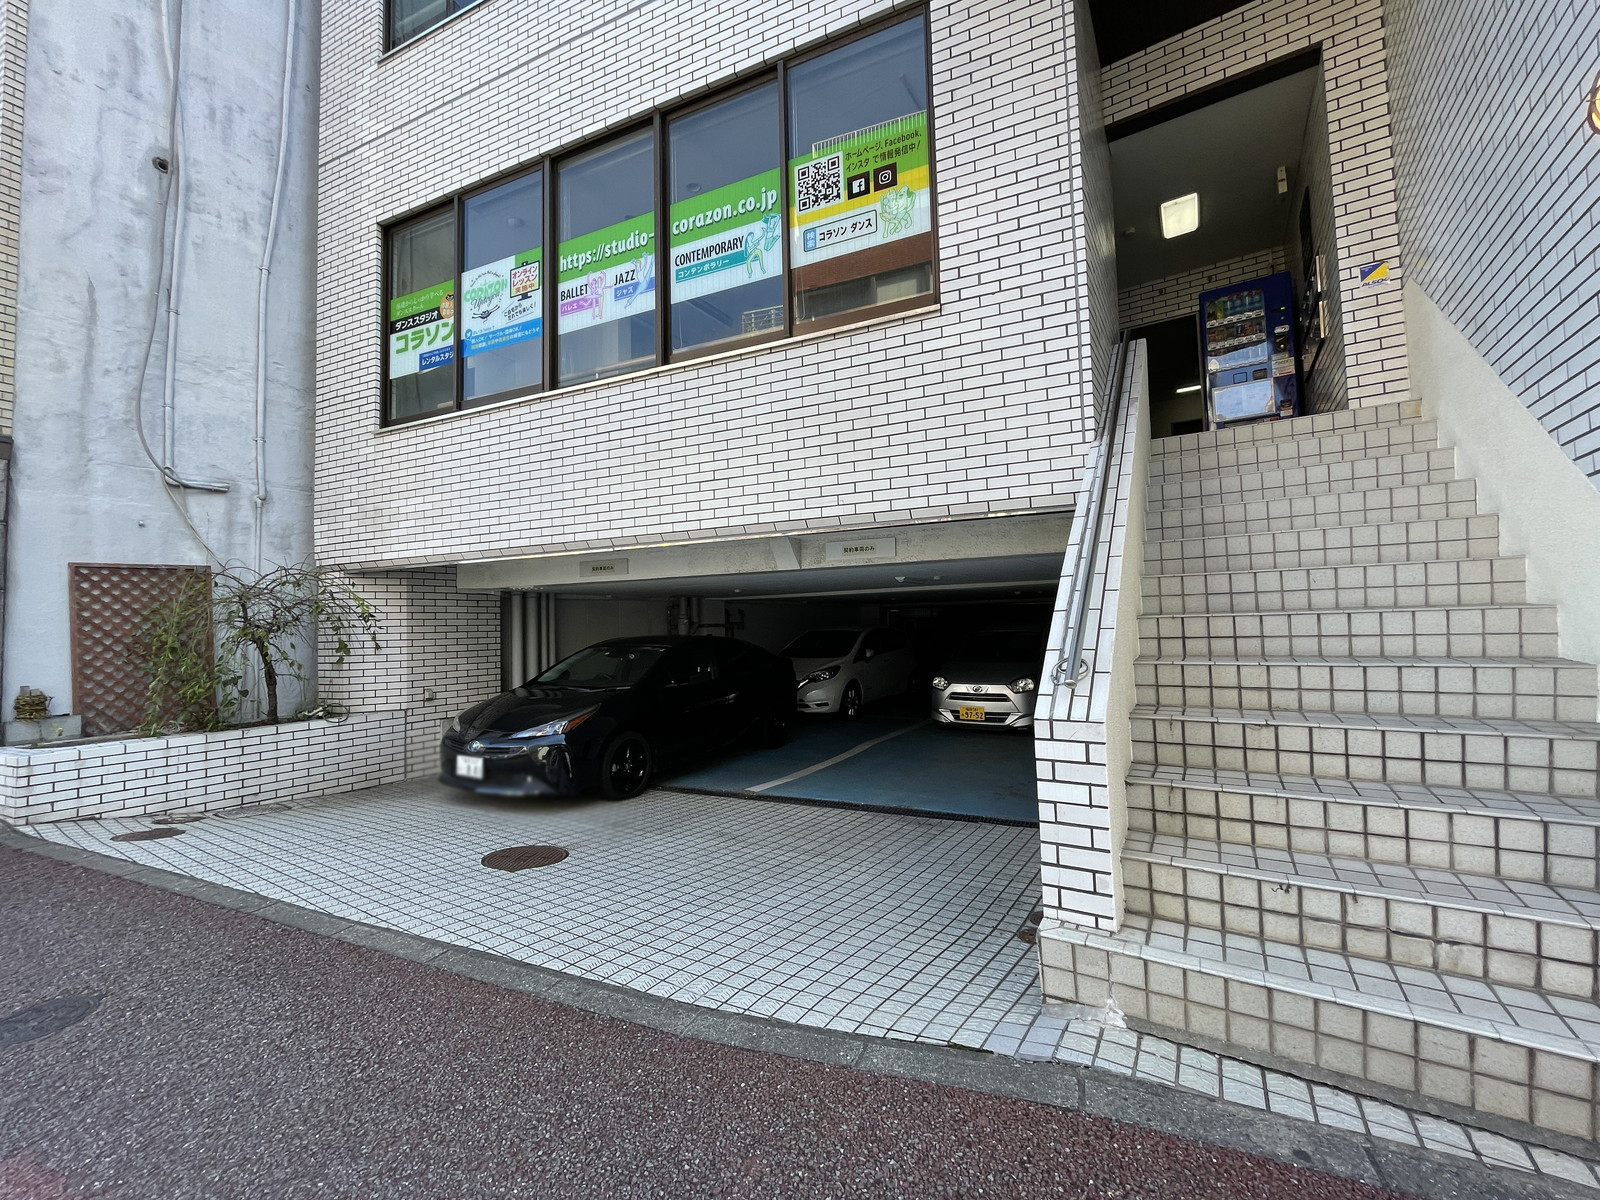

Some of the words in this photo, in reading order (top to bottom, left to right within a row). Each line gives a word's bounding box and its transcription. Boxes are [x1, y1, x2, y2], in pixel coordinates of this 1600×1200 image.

[846, 158, 870, 173] インスタ
[672, 187, 777, 235] corazon.co.jp
[819, 226, 847, 242] コラソン
[850, 218, 873, 233] ダンス
[560, 230, 655, 273] https://studio-
[675, 235, 744, 267] CONTEMPORARY
[512, 266, 538, 280] オンライン
[614, 269, 636, 286] JAZZ
[678, 259, 730, 278] コンテンポラリー
[464, 279, 508, 302] CORAZON
[512, 274, 538, 288] レッスン
[560, 283, 588, 302] BALLET
[616, 285, 634, 297] ジャズ
[561, 303, 579, 312] バレエ
[395, 310, 438, 331] ダンススタジオ
[396, 322, 454, 354] コラソン
